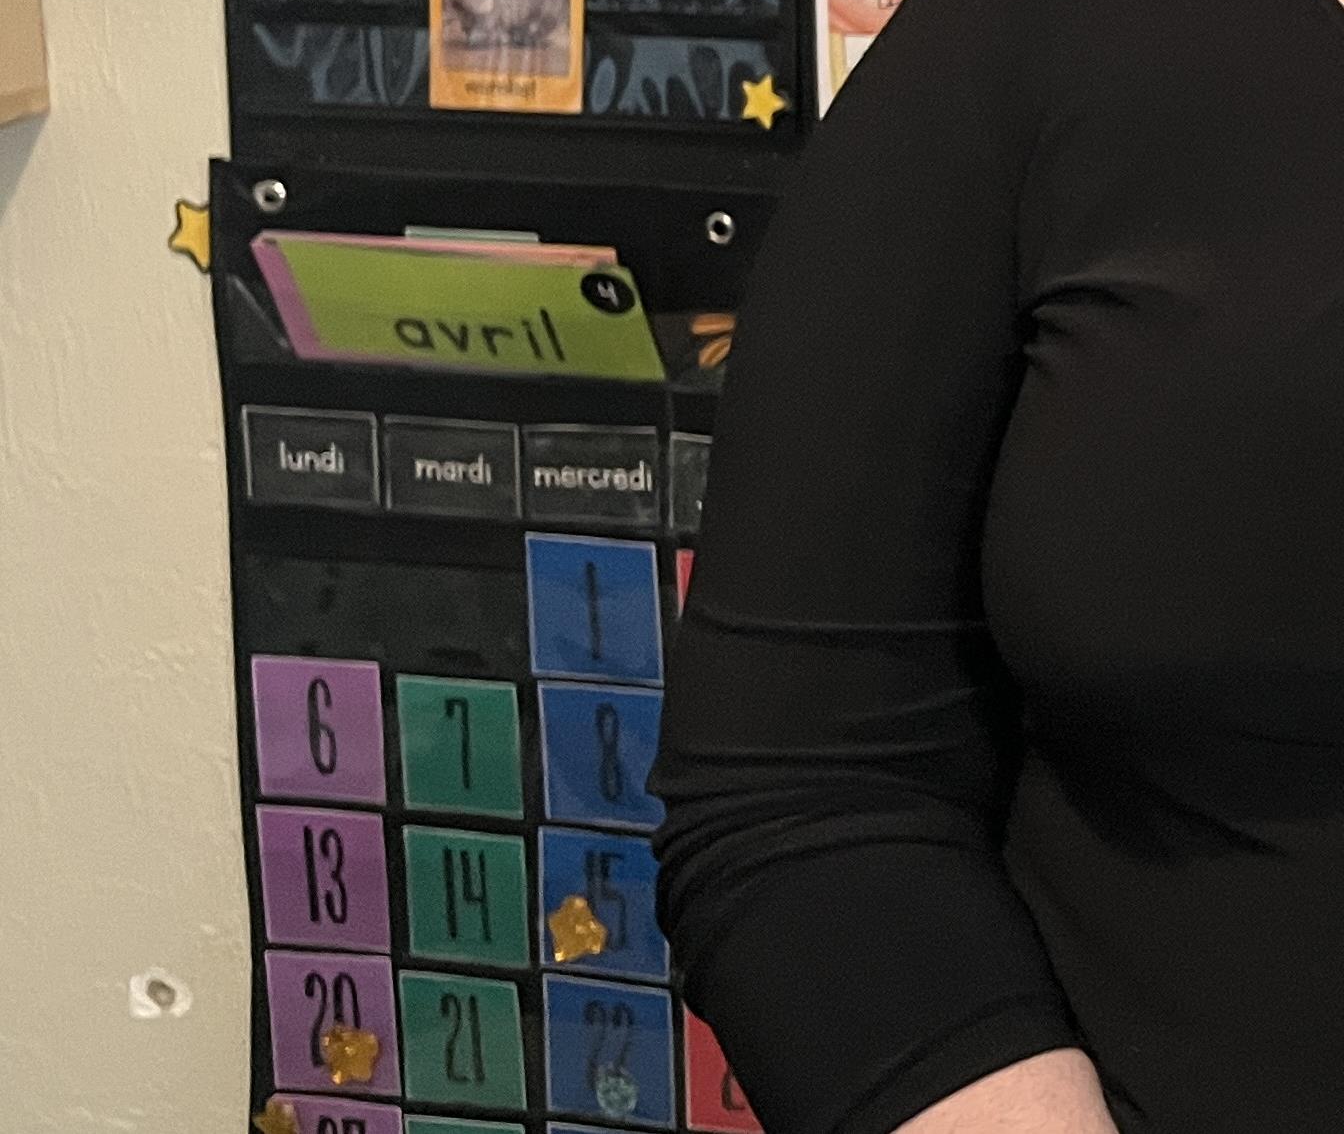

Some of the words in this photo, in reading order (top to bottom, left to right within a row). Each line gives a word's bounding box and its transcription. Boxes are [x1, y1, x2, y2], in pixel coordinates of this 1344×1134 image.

[392, 307, 566, 363] avril
[278, 441, 345, 475] lundi
[413, 453, 493, 487] mardi
[533, 460, 654, 493] mercredi
[306, 677, 338, 776] 6
[443, 696, 474, 791] 7
[302, 824, 349, 926] 13
[442, 845, 493, 945] 14
[439, 992, 486, 1089] 21
